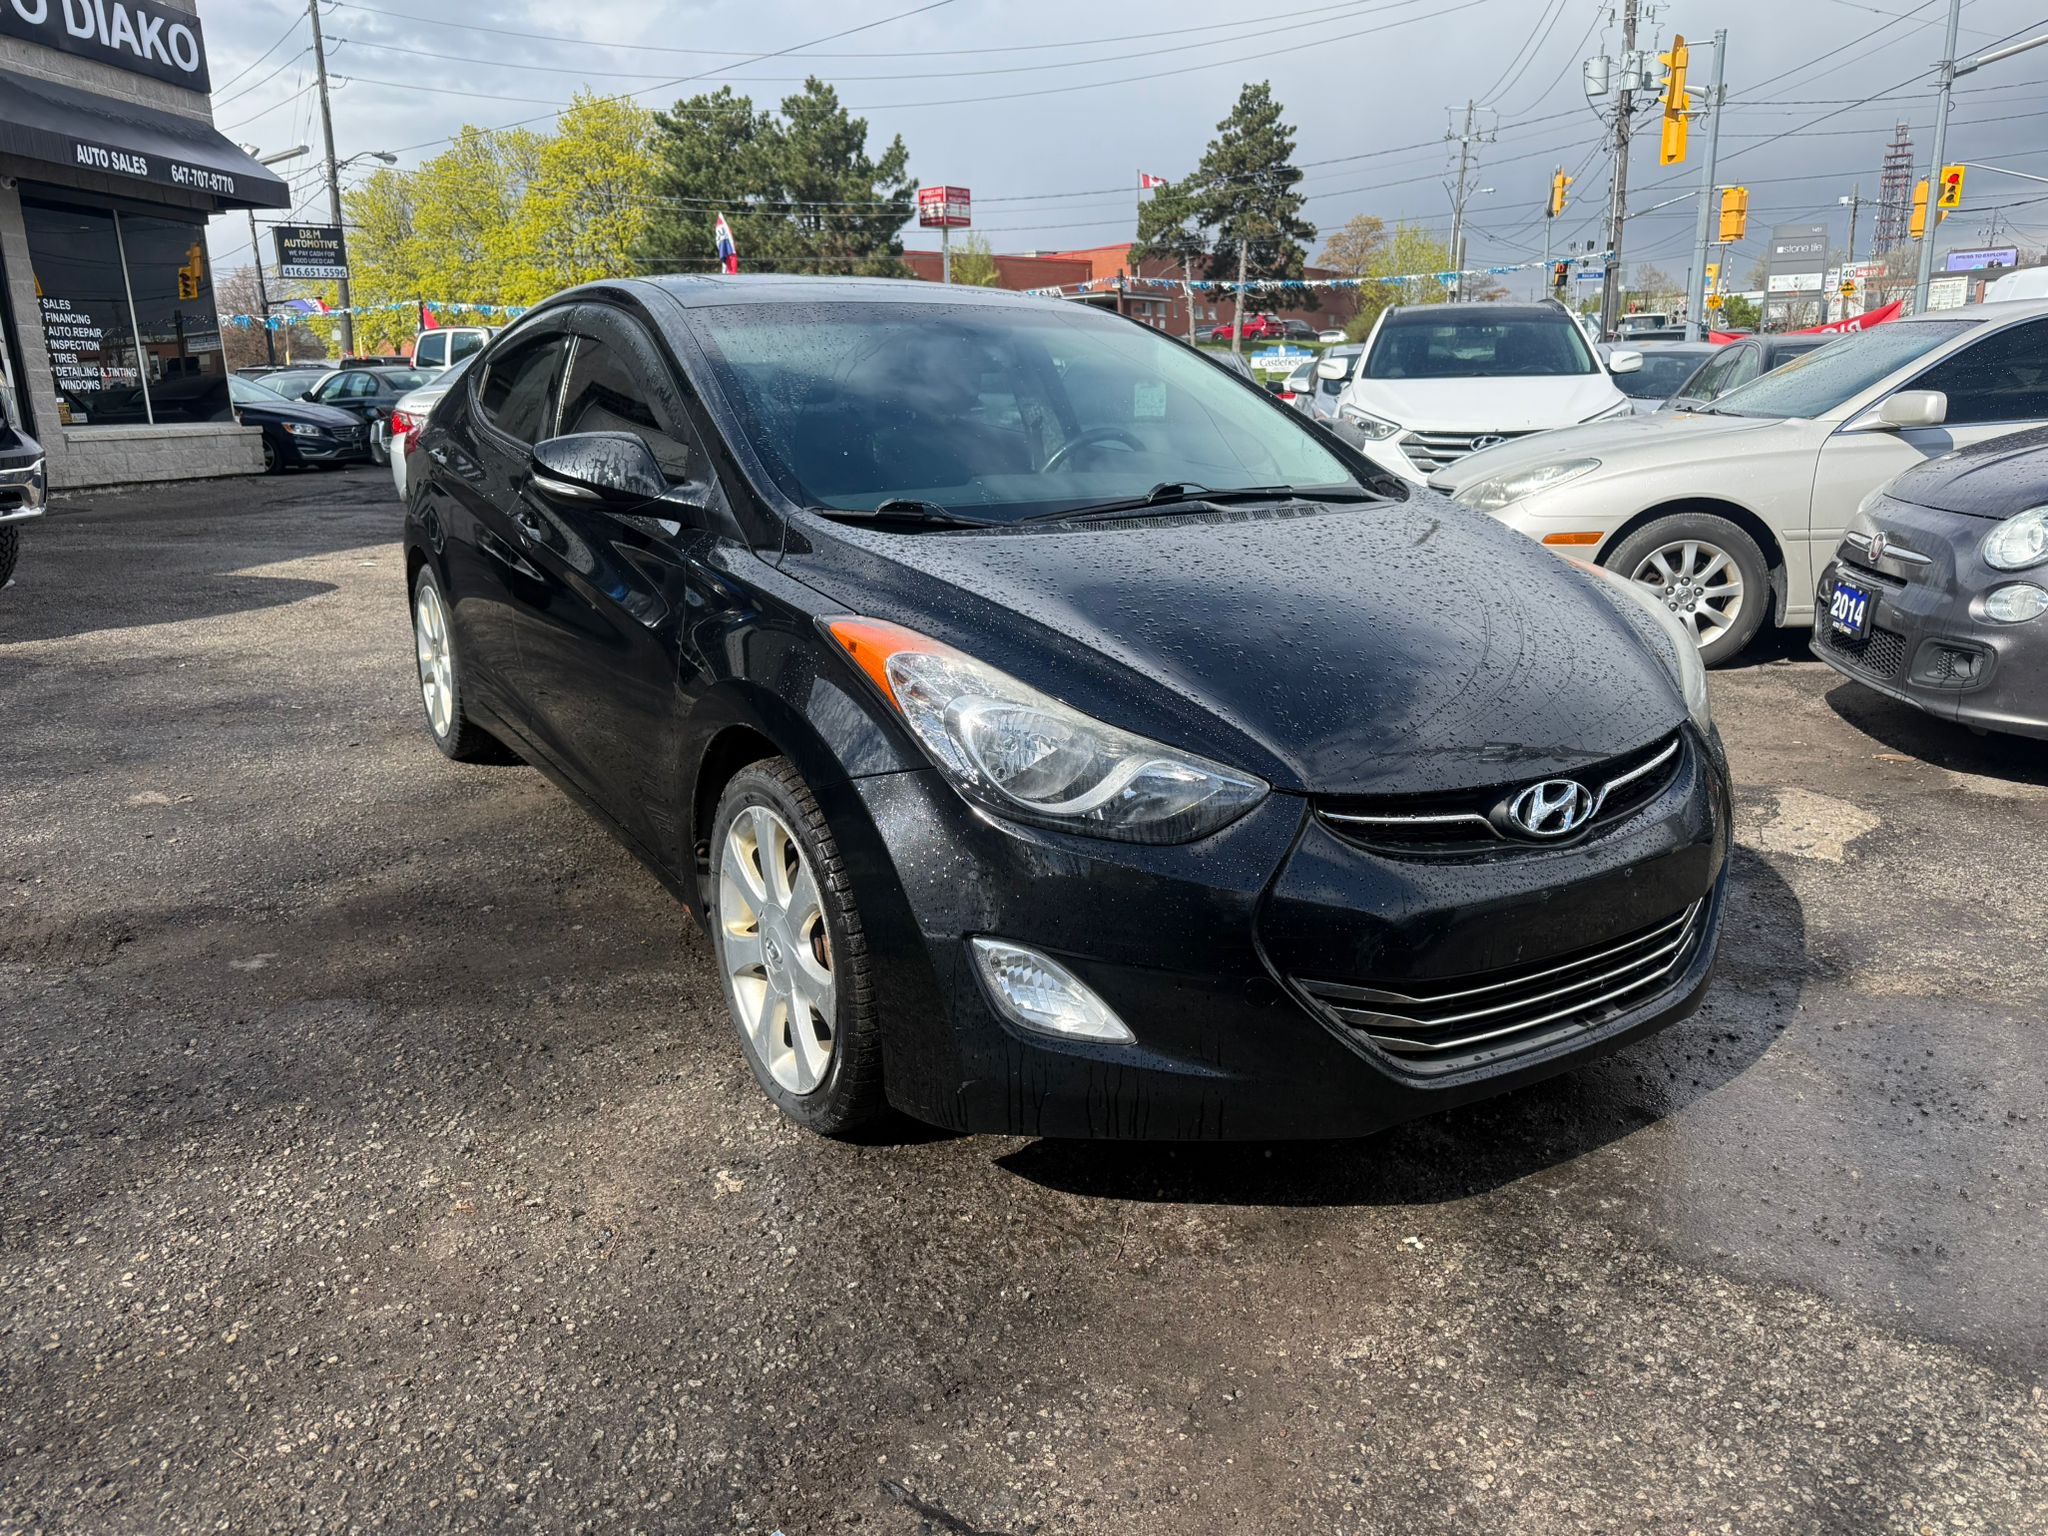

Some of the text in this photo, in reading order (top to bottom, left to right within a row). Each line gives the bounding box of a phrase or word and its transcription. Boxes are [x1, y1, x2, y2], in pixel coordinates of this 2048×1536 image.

[61, 0, 200, 73] DIAKO
[76, 144, 148, 176] AUTO SALES
[171, 164, 235, 194] 647-707-8770
[283, 238, 339, 249] AUTOMOTIVE
[1783, 242, 1823, 254] stone tile
[284, 267, 346, 277] 416.651.5596
[1842, 269, 1855, 278] 40
[42, 298, 71, 310] SALES
[45, 312, 91, 325] FINANCING
[48, 326, 103, 338] AUTO REPAIR
[50, 339, 100, 351] INSPECTION
[53, 353, 78, 364] TIRES
[55, 366, 137, 377] DETAILING & TINTING
[59, 380, 101, 390] WINDOWS
[1830, 590, 1865, 627] 2014
